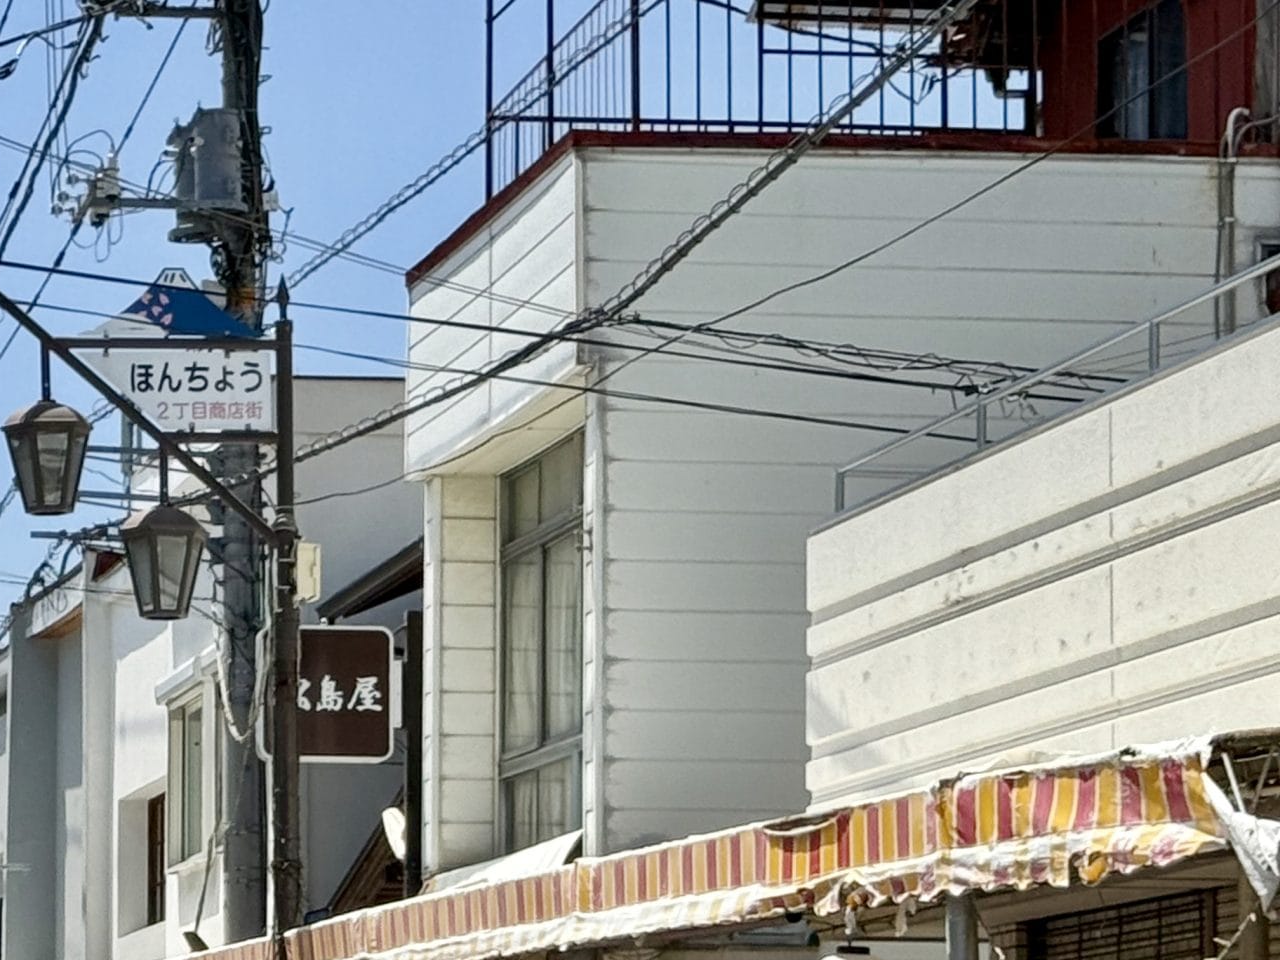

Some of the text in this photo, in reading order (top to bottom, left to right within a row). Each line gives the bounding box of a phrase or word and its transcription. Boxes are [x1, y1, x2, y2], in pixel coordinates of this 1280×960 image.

[131, 361, 263, 393] ほんちょう
[157, 401, 263, 420] 2丁目商店街
